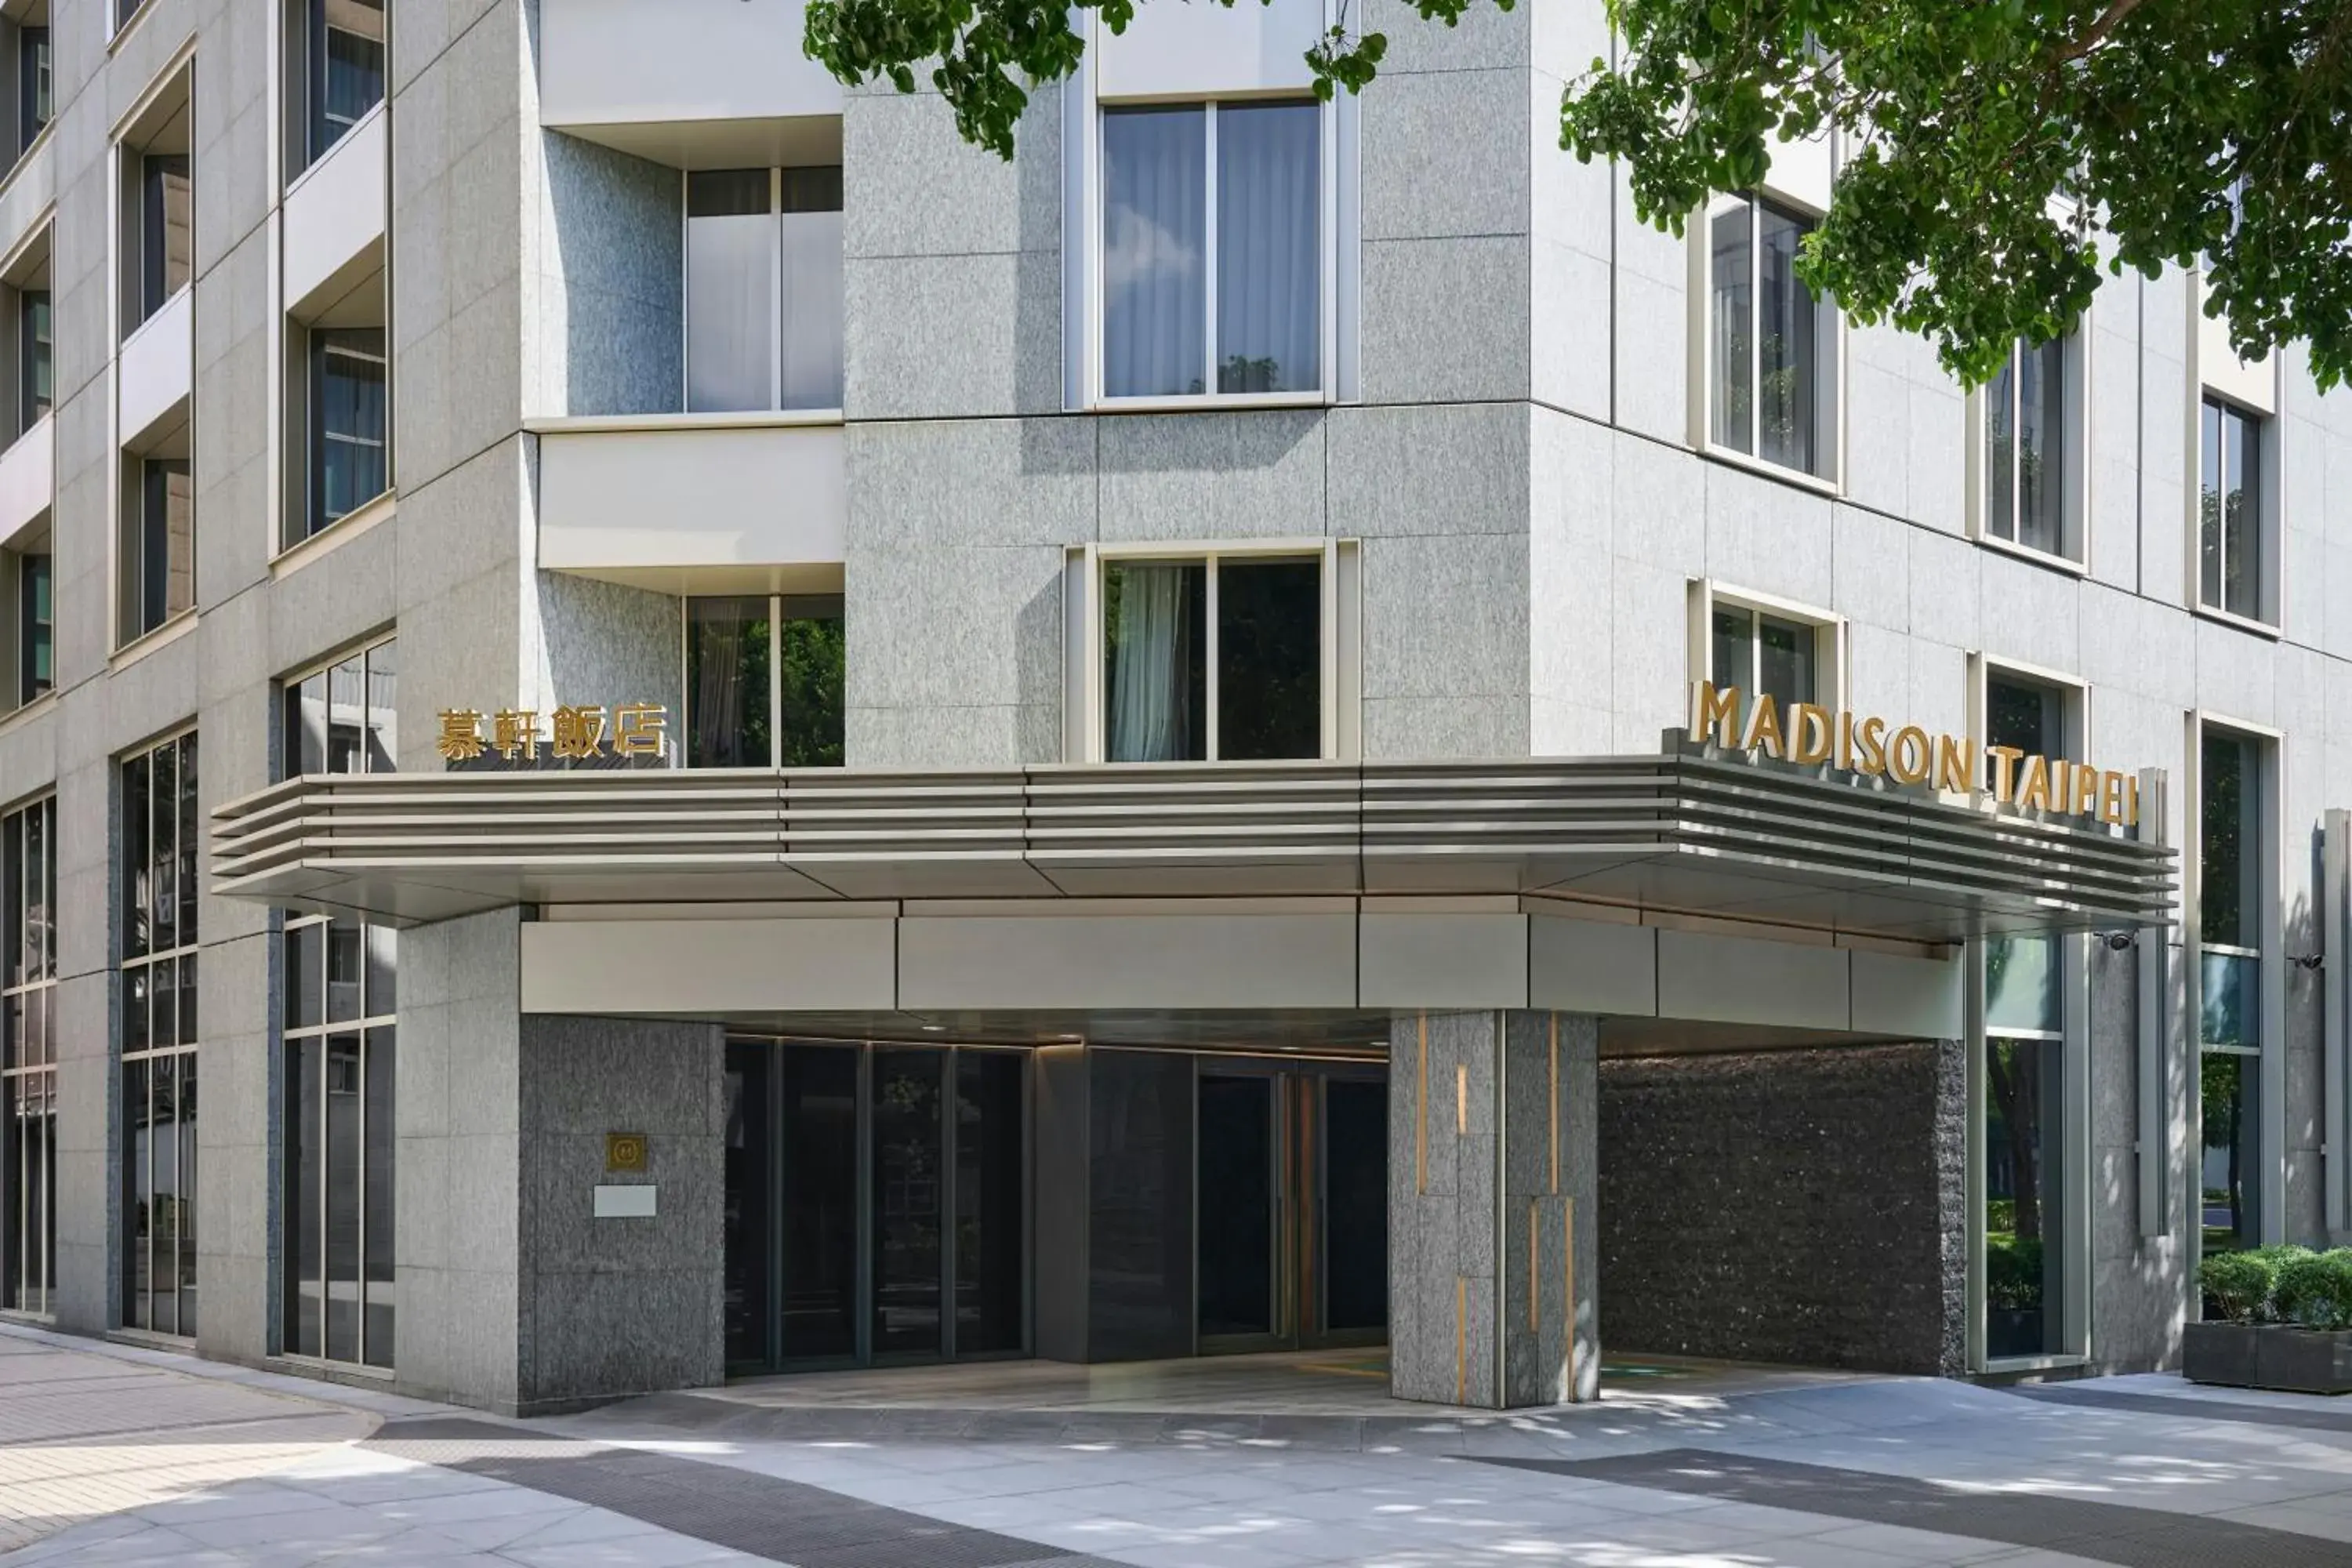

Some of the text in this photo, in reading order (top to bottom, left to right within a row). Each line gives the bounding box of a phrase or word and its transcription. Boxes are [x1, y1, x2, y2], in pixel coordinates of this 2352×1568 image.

[437, 702, 666, 759] 慕軒飯店
[1690, 681, 2138, 826] MADISON TAIPEI
